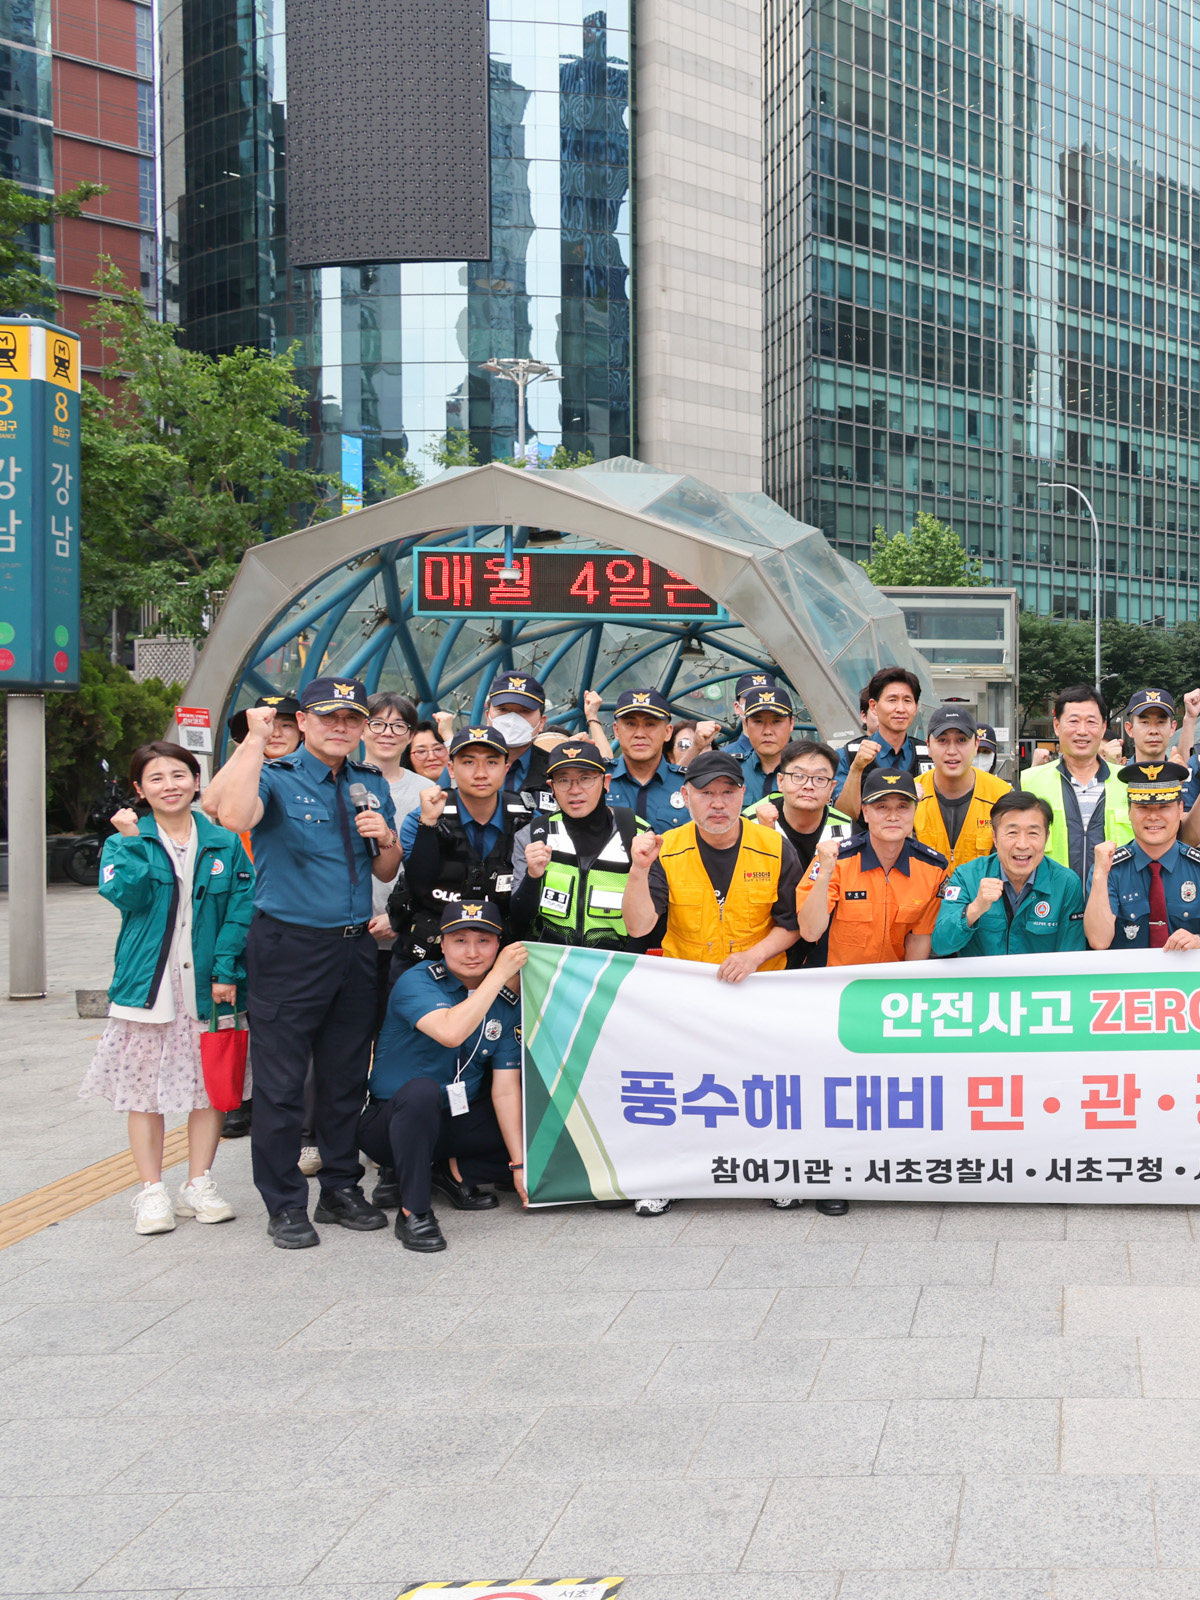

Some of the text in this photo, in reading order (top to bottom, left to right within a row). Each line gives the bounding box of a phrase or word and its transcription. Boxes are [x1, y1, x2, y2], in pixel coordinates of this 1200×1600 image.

[54, 391, 69, 423] 8
[0, 420, 18, 432] 입구
[52, 425, 71, 440] 출입구
[51, 462, 73, 558] 강남
[424, 555, 532, 607] 매월
[432, 888, 462, 902] OLIC
[880, 990, 1073, 1038] 안전사고
[620, 1070, 803, 1131] 풍수해
[823, 1075, 944, 1132] 대비
[710, 1156, 834, 1184] 참여기관
[864, 1158, 1014, 1184] 서초경찰서
[1045, 1157, 1164, 1183] 서초구청
